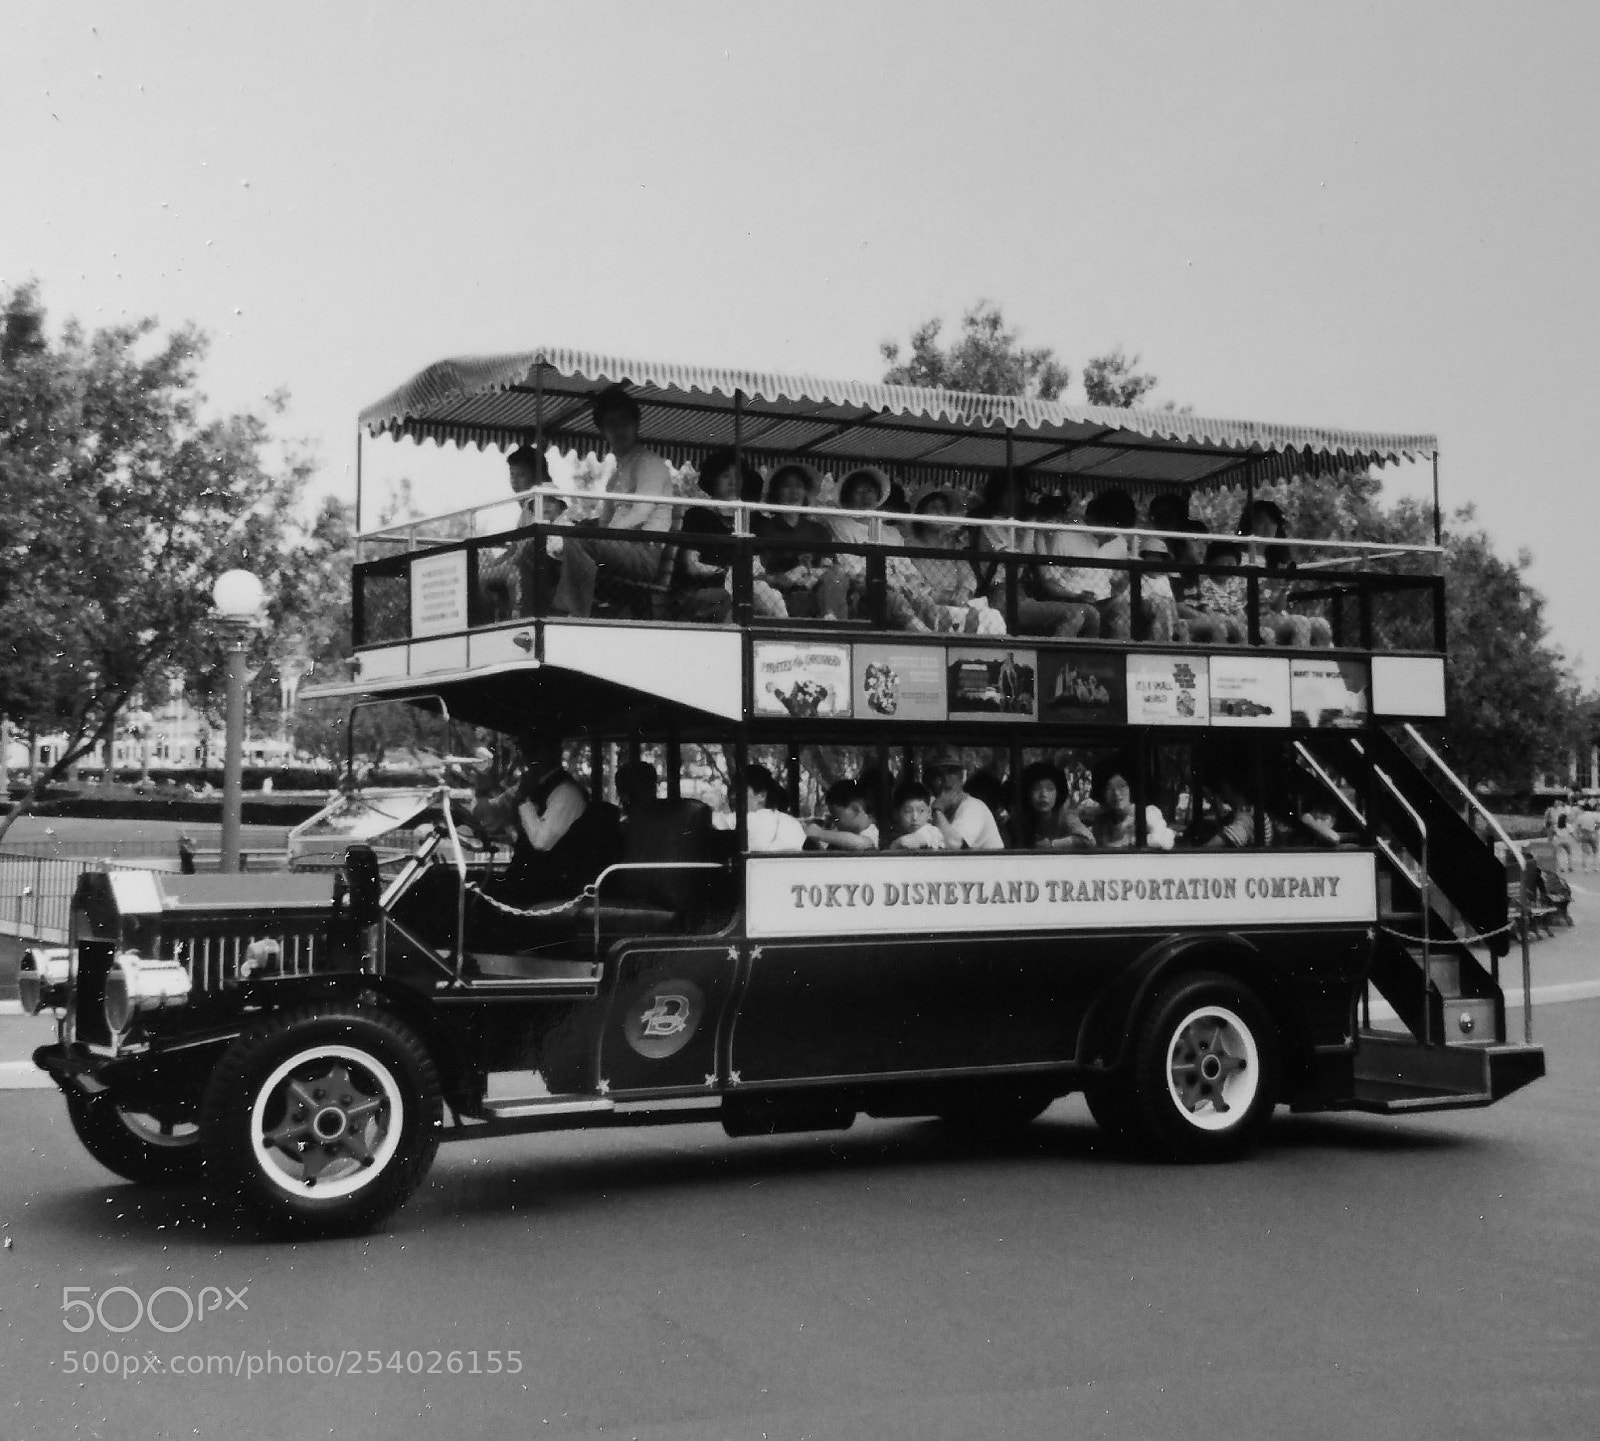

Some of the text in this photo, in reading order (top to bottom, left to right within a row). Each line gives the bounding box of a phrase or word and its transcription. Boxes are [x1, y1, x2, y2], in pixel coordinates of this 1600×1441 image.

[791, 876, 1340, 908] TOKYO DISNEYLAND TRANSPORTATION COMPANY
